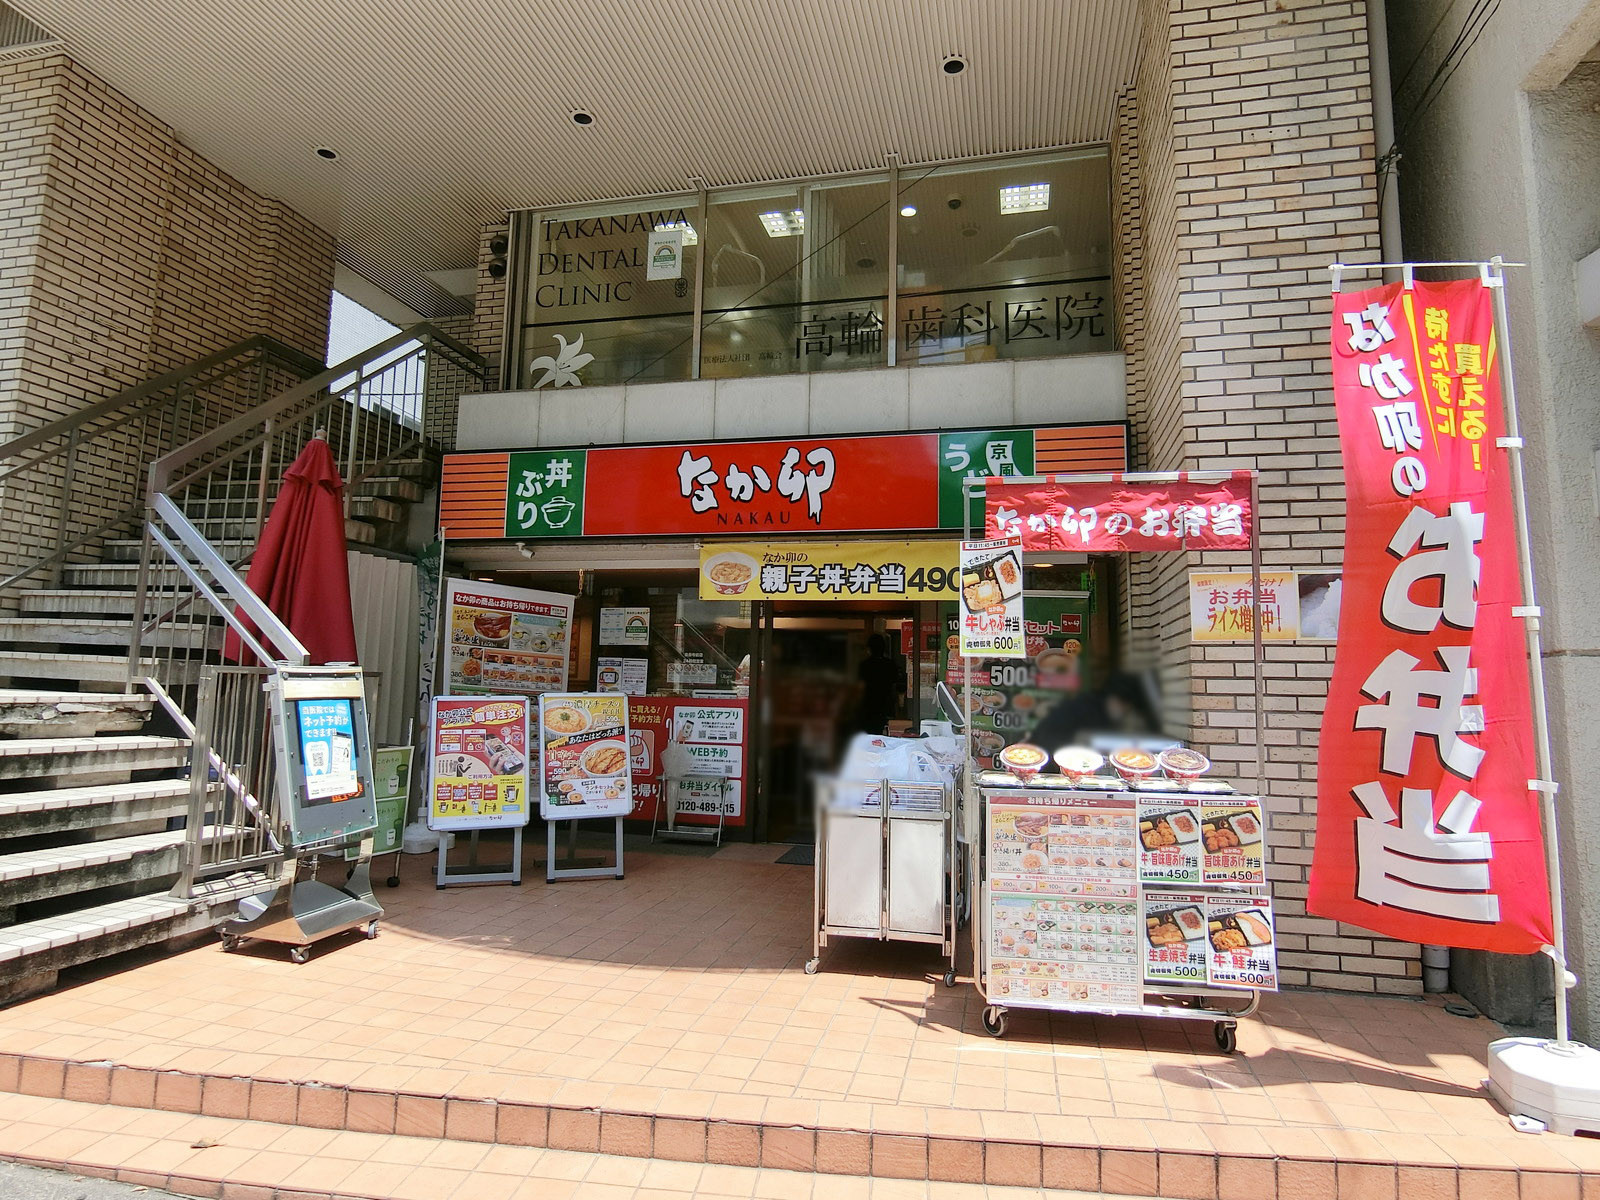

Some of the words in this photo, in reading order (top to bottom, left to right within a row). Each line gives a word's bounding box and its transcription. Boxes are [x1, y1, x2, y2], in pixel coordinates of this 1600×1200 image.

[538, 248, 643, 276] DENTAL
[536, 281, 632, 308] CLINIC
[677, 446, 836, 524] なか卯
[717, 511, 791, 525] NAKAU
[762, 552, 808, 563] なか卯の
[697, 709, 739, 720] 公式アプリ
